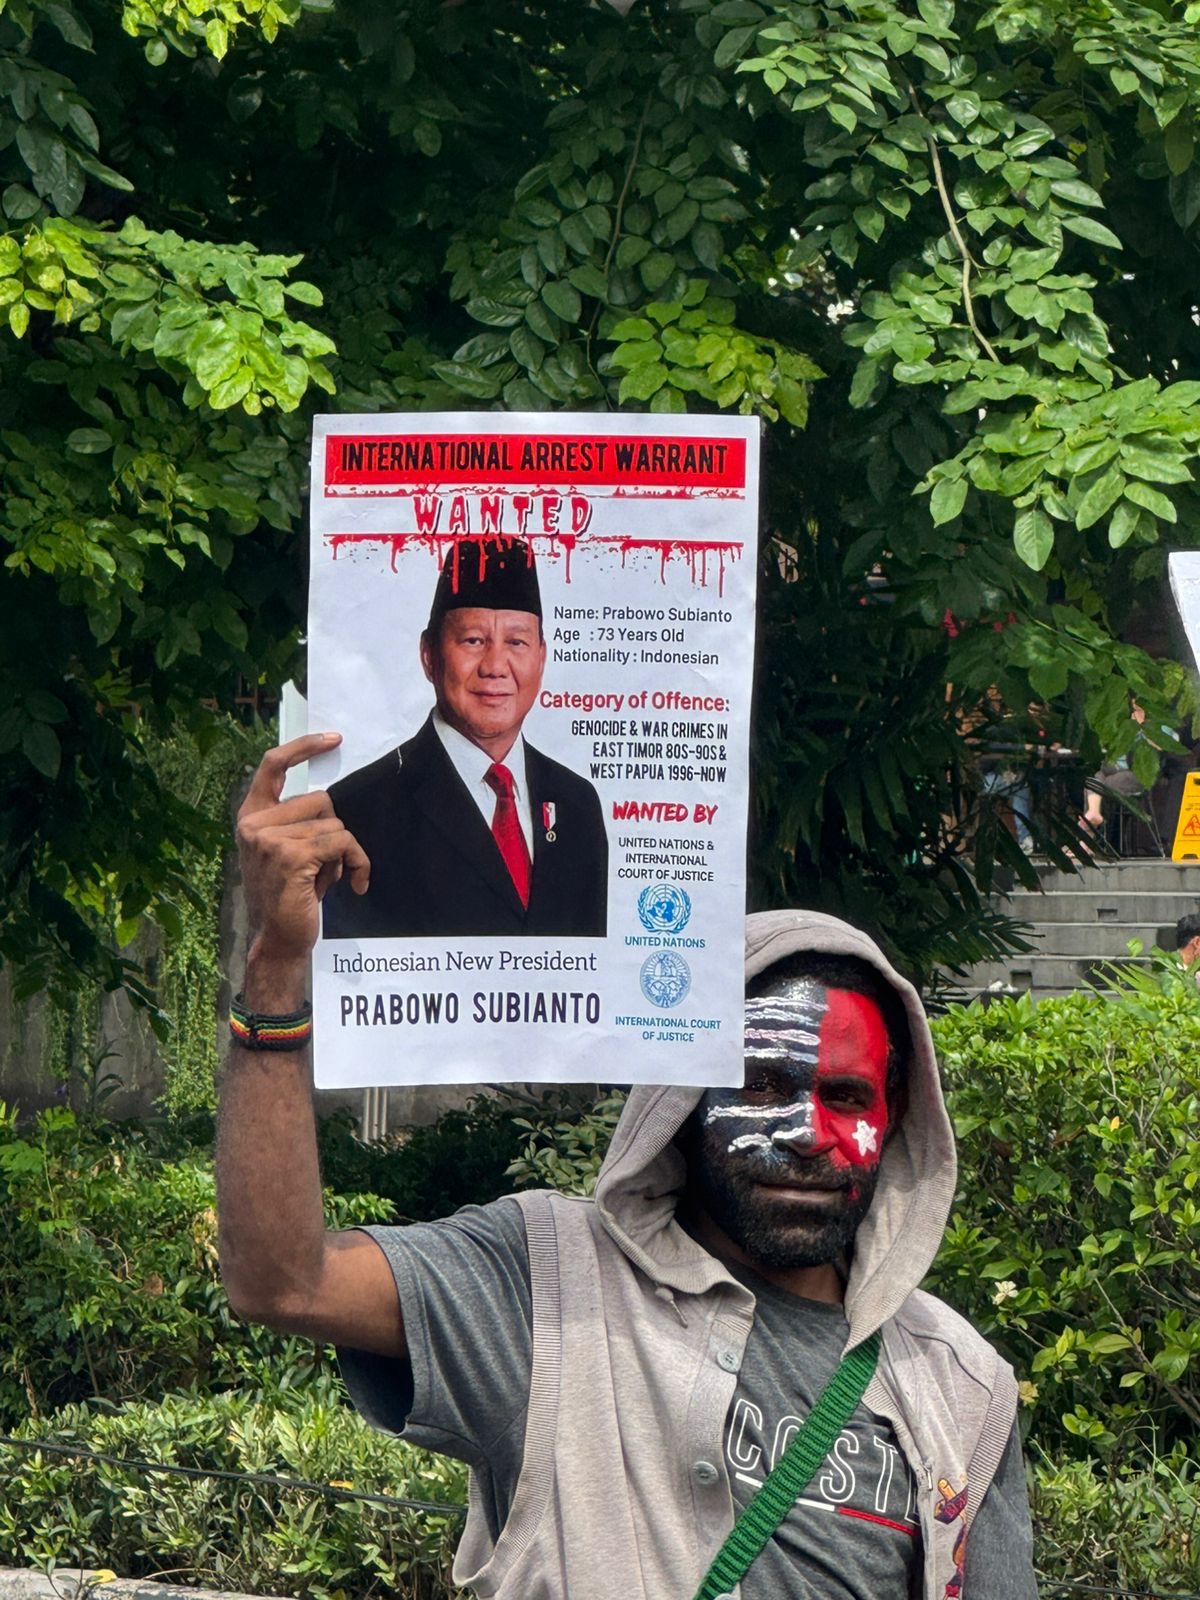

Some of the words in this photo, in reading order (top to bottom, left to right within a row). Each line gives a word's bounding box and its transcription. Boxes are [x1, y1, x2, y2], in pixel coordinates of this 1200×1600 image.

[341, 441, 513, 471] INTERNATIONAL
[519, 442, 608, 472] ARREST
[615, 443, 728, 474] WARRANT
[413, 493, 593, 537] WANTED
[554, 606, 599, 620] Name:
[602, 606, 665, 621] Prabowo
[668, 608, 733, 623] Subianto
[553, 628, 581, 643] Age
[597, 628, 615, 641] 73
[618, 628, 658, 642] Years
[661, 629, 685, 642] Old
[640, 650, 719, 665] Indonesian
[539, 690, 625, 712] Category
[628, 690, 648, 709] of
[652, 692, 730, 712] Offence:
[571, 720, 627, 736] GENOCIDE
[629, 721, 639, 736] &
[641, 722, 669, 738] WAR
[671, 723, 715, 739] CRIMES
[716, 724, 728, 740] IN
[593, 742, 624, 758] EAST
[626, 742, 663, 759] TIMOR
[665, 743, 717, 761] 80S-90S
[719, 745, 727, 761] &
[590, 763, 623, 779] WEST
[625, 764, 665, 780] PAPUA
[667, 765, 727, 783] 1996-NOW
[612, 801, 689, 823] WANTED
[693, 804, 719, 825] BY
[618, 837, 657, 848] UNITED
[658, 839, 705, 850] NATIONS
[707, 841, 715, 851] &
[625, 853, 708, 866] INTERNATIONAL
[617, 869, 654, 879] COURT
[656, 870, 670, 880] OF
[671, 871, 714, 882] JUSTICE
[624, 936, 662, 947] UNITED
[663, 937, 706, 949] NATIONS
[332, 952, 441, 974] Indonesian
[445, 951, 494, 972] New
[499, 951, 598, 972] President
[340, 993, 459, 1027] PRABOWO
[472, 992, 601, 1025] SUBIANTO
[615, 1016, 689, 1029] INTERNATIONAL
[690, 1018, 722, 1030] COURT
[642, 1031, 656, 1041] OF
[657, 1032, 695, 1043] JUSTICE
